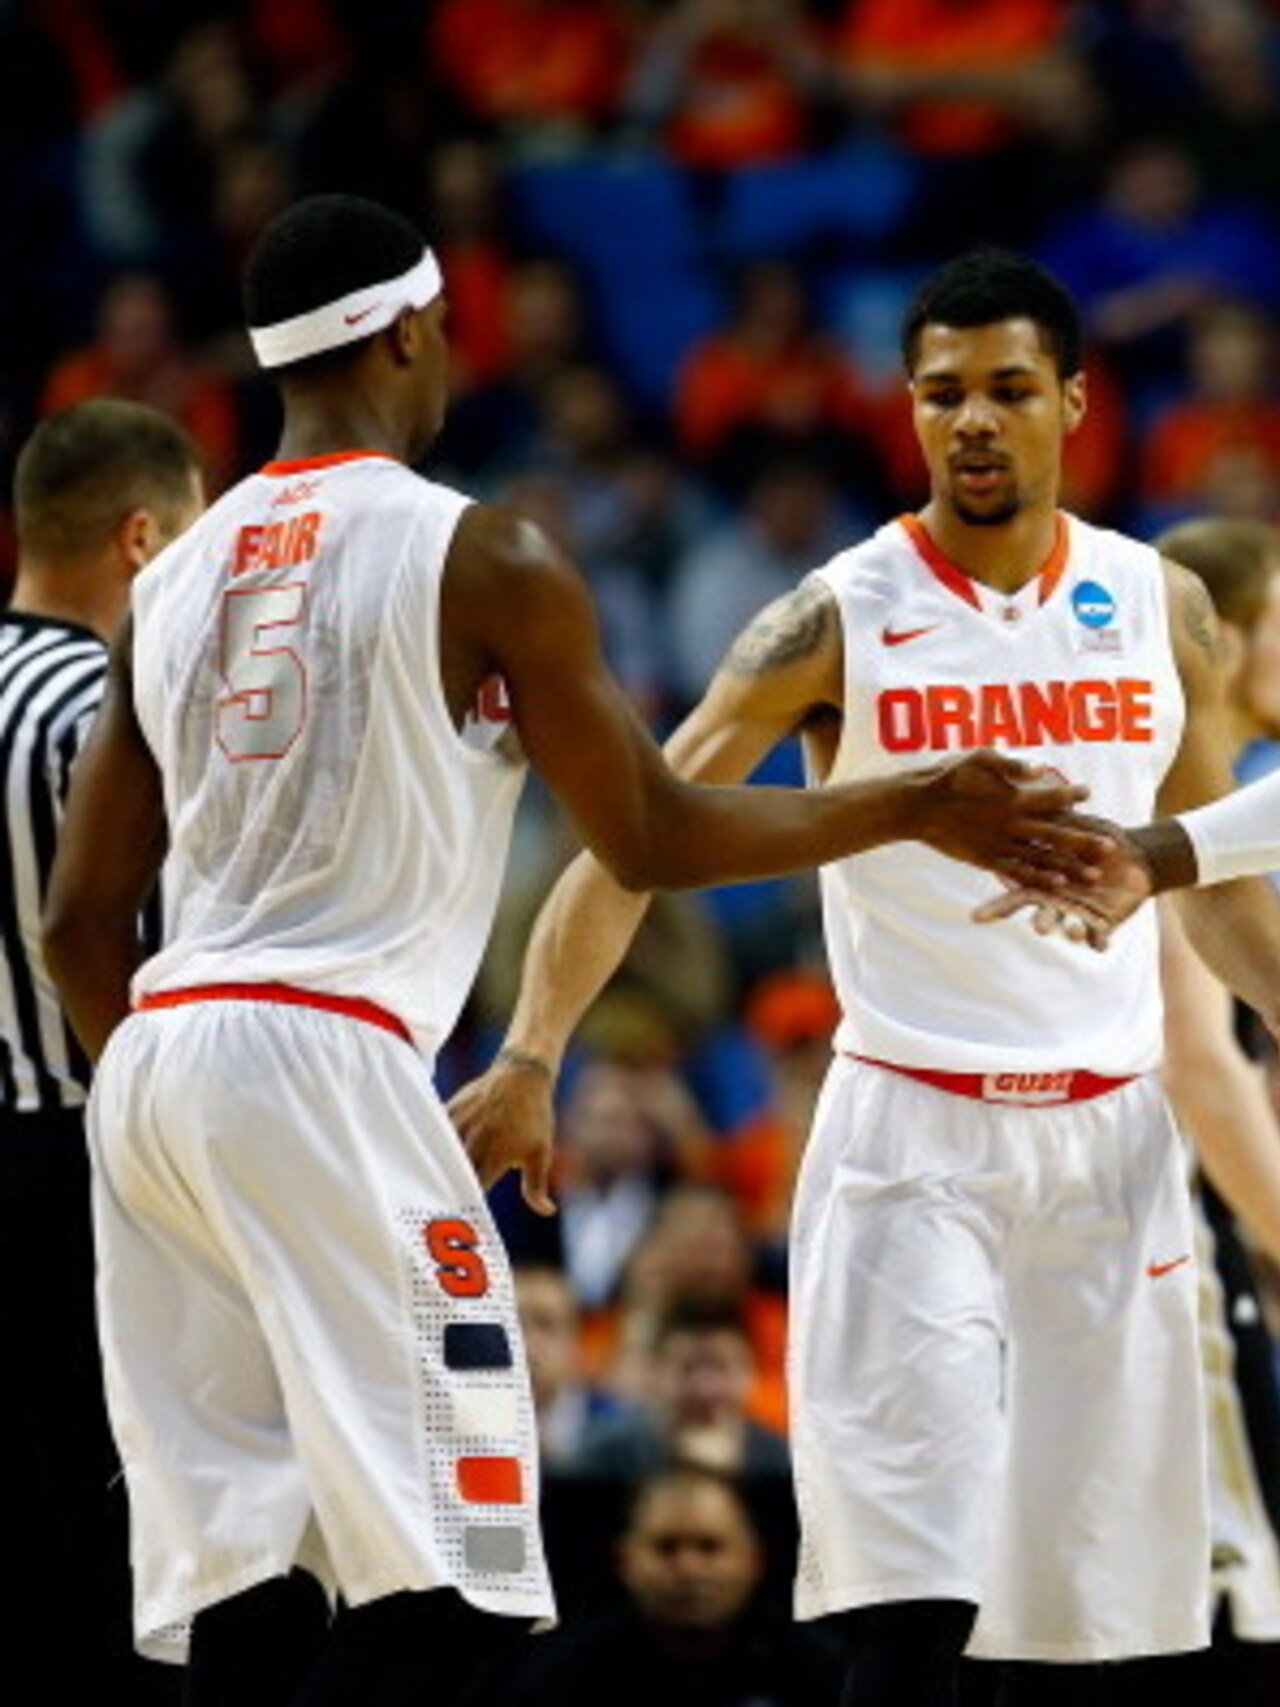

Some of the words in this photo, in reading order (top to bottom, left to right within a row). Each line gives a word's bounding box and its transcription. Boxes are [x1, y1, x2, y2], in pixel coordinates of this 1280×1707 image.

[232, 512, 321, 577] FAIR
[215, 583, 307, 762] 5
[877, 679, 1154, 754] ORANGE
[424, 1219, 488, 1298] S
